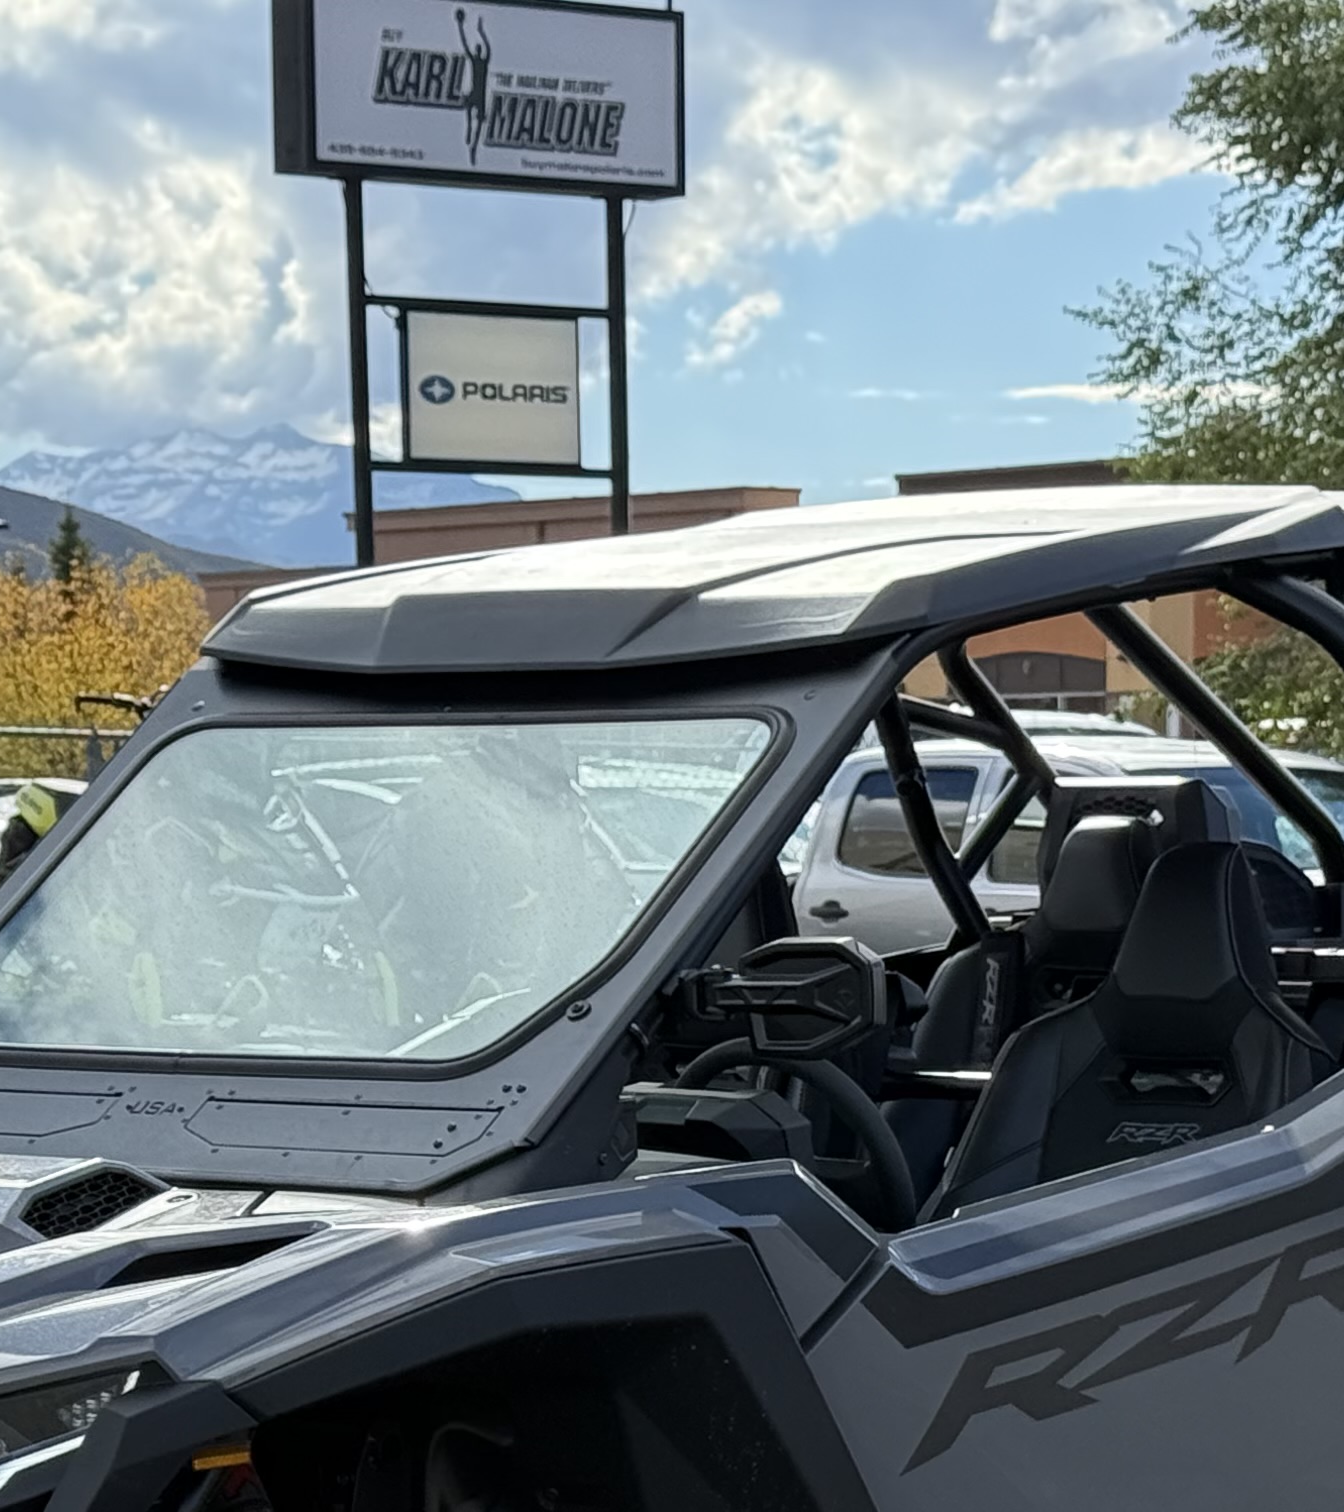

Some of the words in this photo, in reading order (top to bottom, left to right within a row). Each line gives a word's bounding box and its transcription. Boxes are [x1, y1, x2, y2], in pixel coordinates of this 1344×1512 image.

[374, 48, 463, 104] KARL
[486, 92, 623, 154] MALONE
[461, 381, 570, 404] POLARIS
[129, 1101, 177, 1116] USA
[1106, 1121, 1202, 1145] RZR
